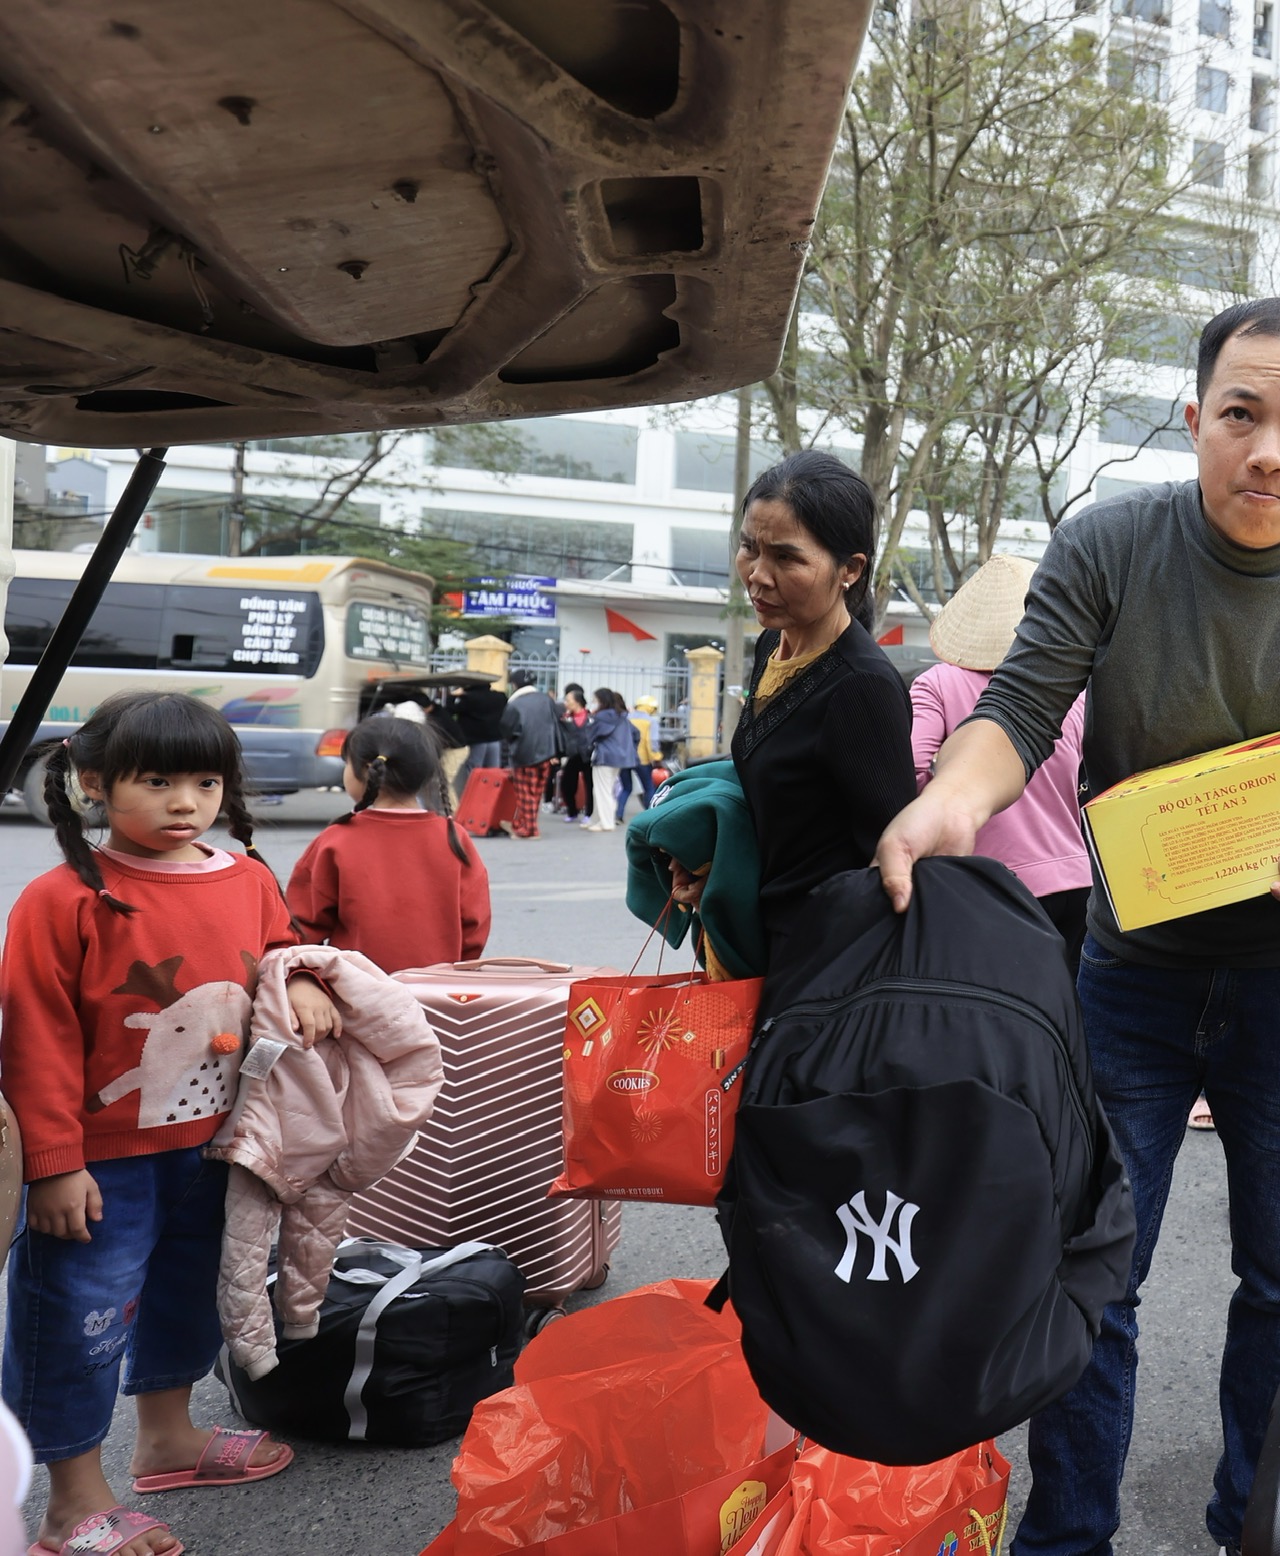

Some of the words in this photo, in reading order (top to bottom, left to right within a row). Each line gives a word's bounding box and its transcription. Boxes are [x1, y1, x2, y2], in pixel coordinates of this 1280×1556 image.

[1159, 803, 1174, 814] BỘ
[1176, 795, 1202, 809] QUÀ
[1203, 785, 1237, 800] TẶNG
[1239, 773, 1276, 791] ORION
[1196, 803, 1218, 816] TẾT
[1223, 798, 1238, 810] AN
[1241, 796, 1247, 805] 3
[1215, 865, 1244, 879] 1,2204
[1245, 862, 1259, 871] kg
[1259, 857, 1268, 867] (7
[613, 1077, 651, 1090] COOKIES
[708, 1094, 718, 1170] バタークッキー
[834, 1190, 920, 1284] NY
[726, 1507, 760, 1533] New
